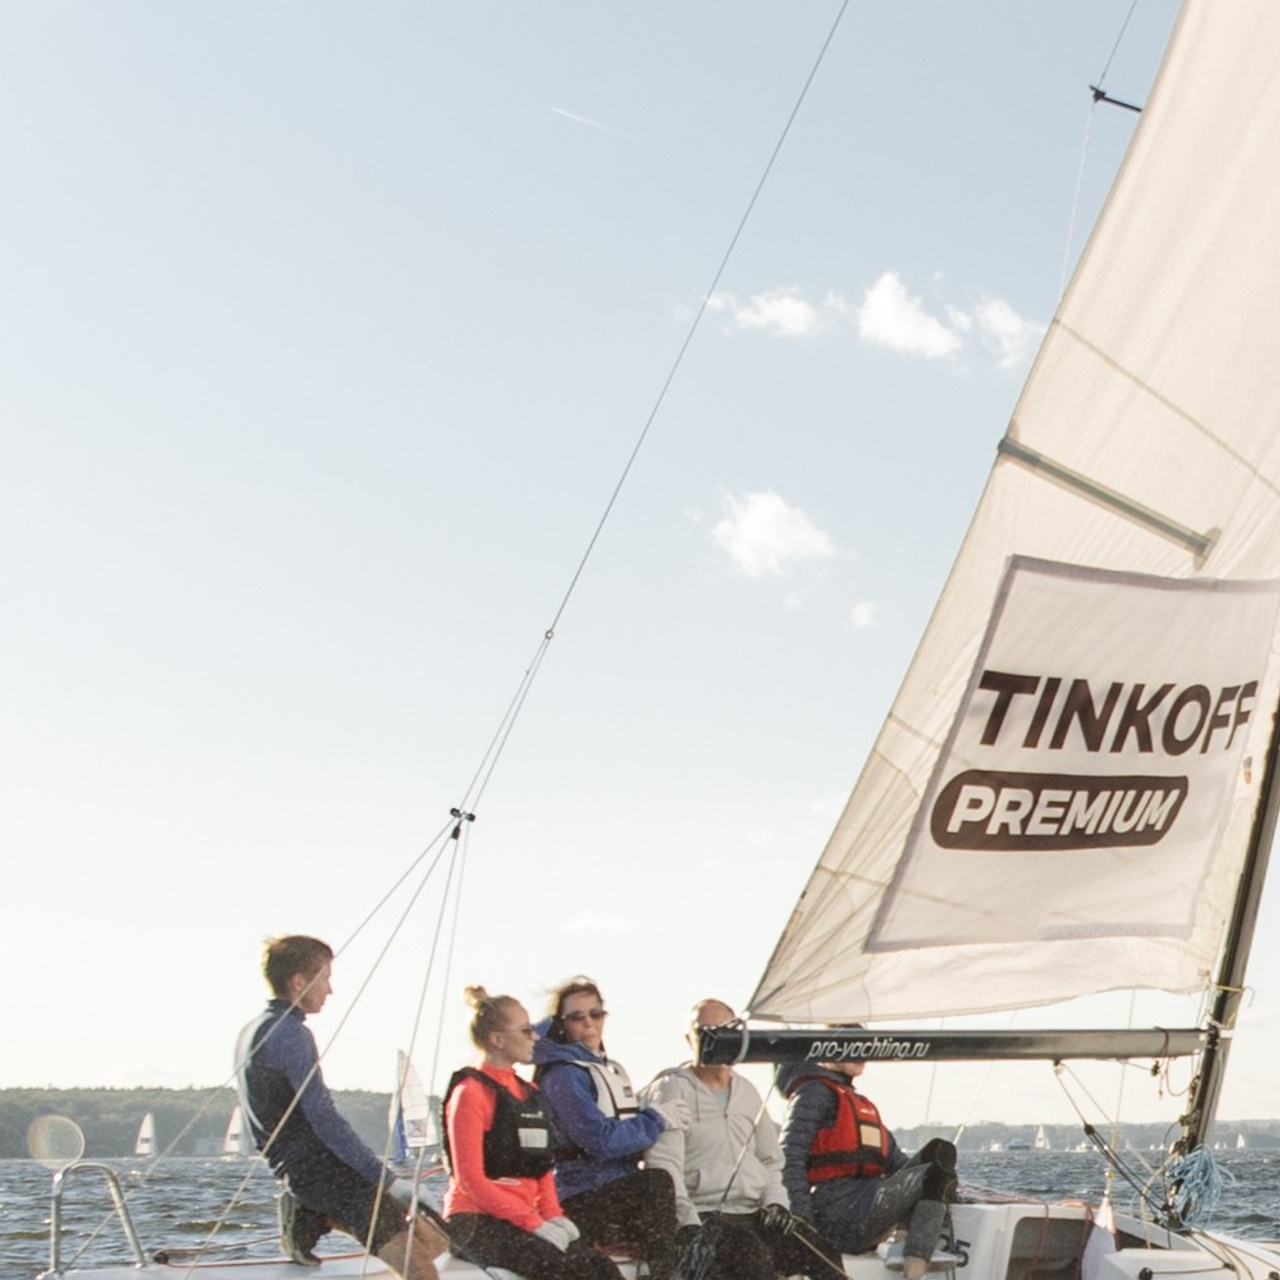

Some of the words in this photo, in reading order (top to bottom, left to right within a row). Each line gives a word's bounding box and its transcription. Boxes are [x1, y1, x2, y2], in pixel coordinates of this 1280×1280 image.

[978, 670, 1259, 756] TINKOFF
[946, 784, 1183, 837] PREMIUM
[804, 1036, 930, 1061] pro-yachting.ru
